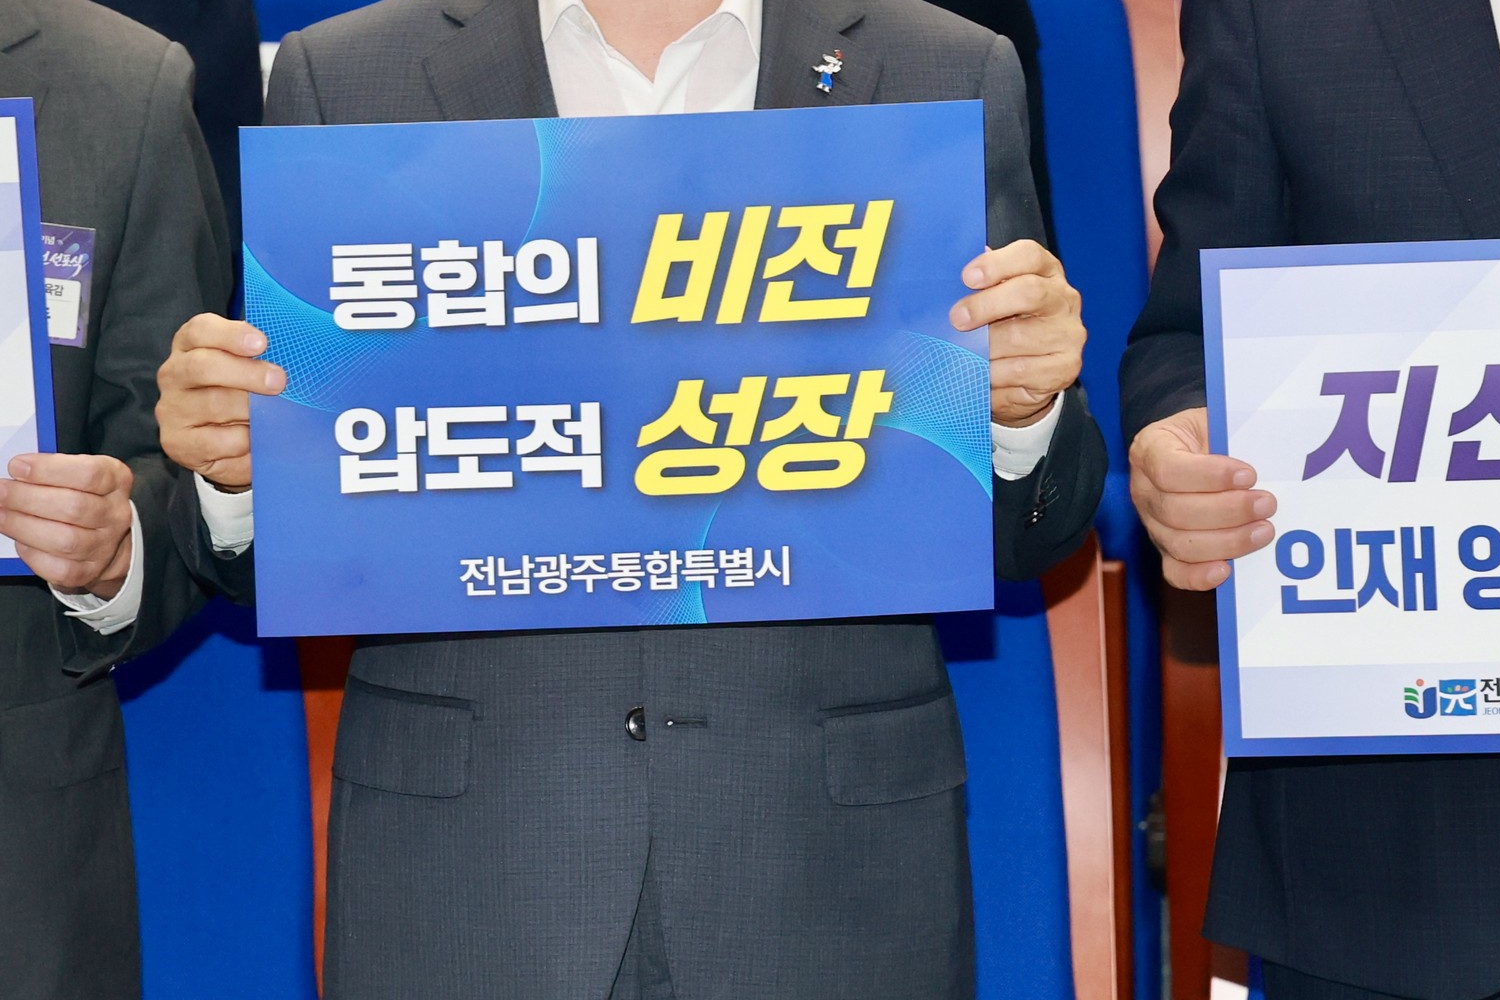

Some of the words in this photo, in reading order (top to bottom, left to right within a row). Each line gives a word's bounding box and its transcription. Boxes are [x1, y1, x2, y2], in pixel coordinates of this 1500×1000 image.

[328, 237, 601, 332] 통합의
[629, 198, 895, 326] 비전
[333, 401, 603, 495] 압도적
[633, 368, 895, 497] 성장
[459, 545, 792, 597] 전남광주통합특별시
[1273, 526, 1438, 615] 인재
